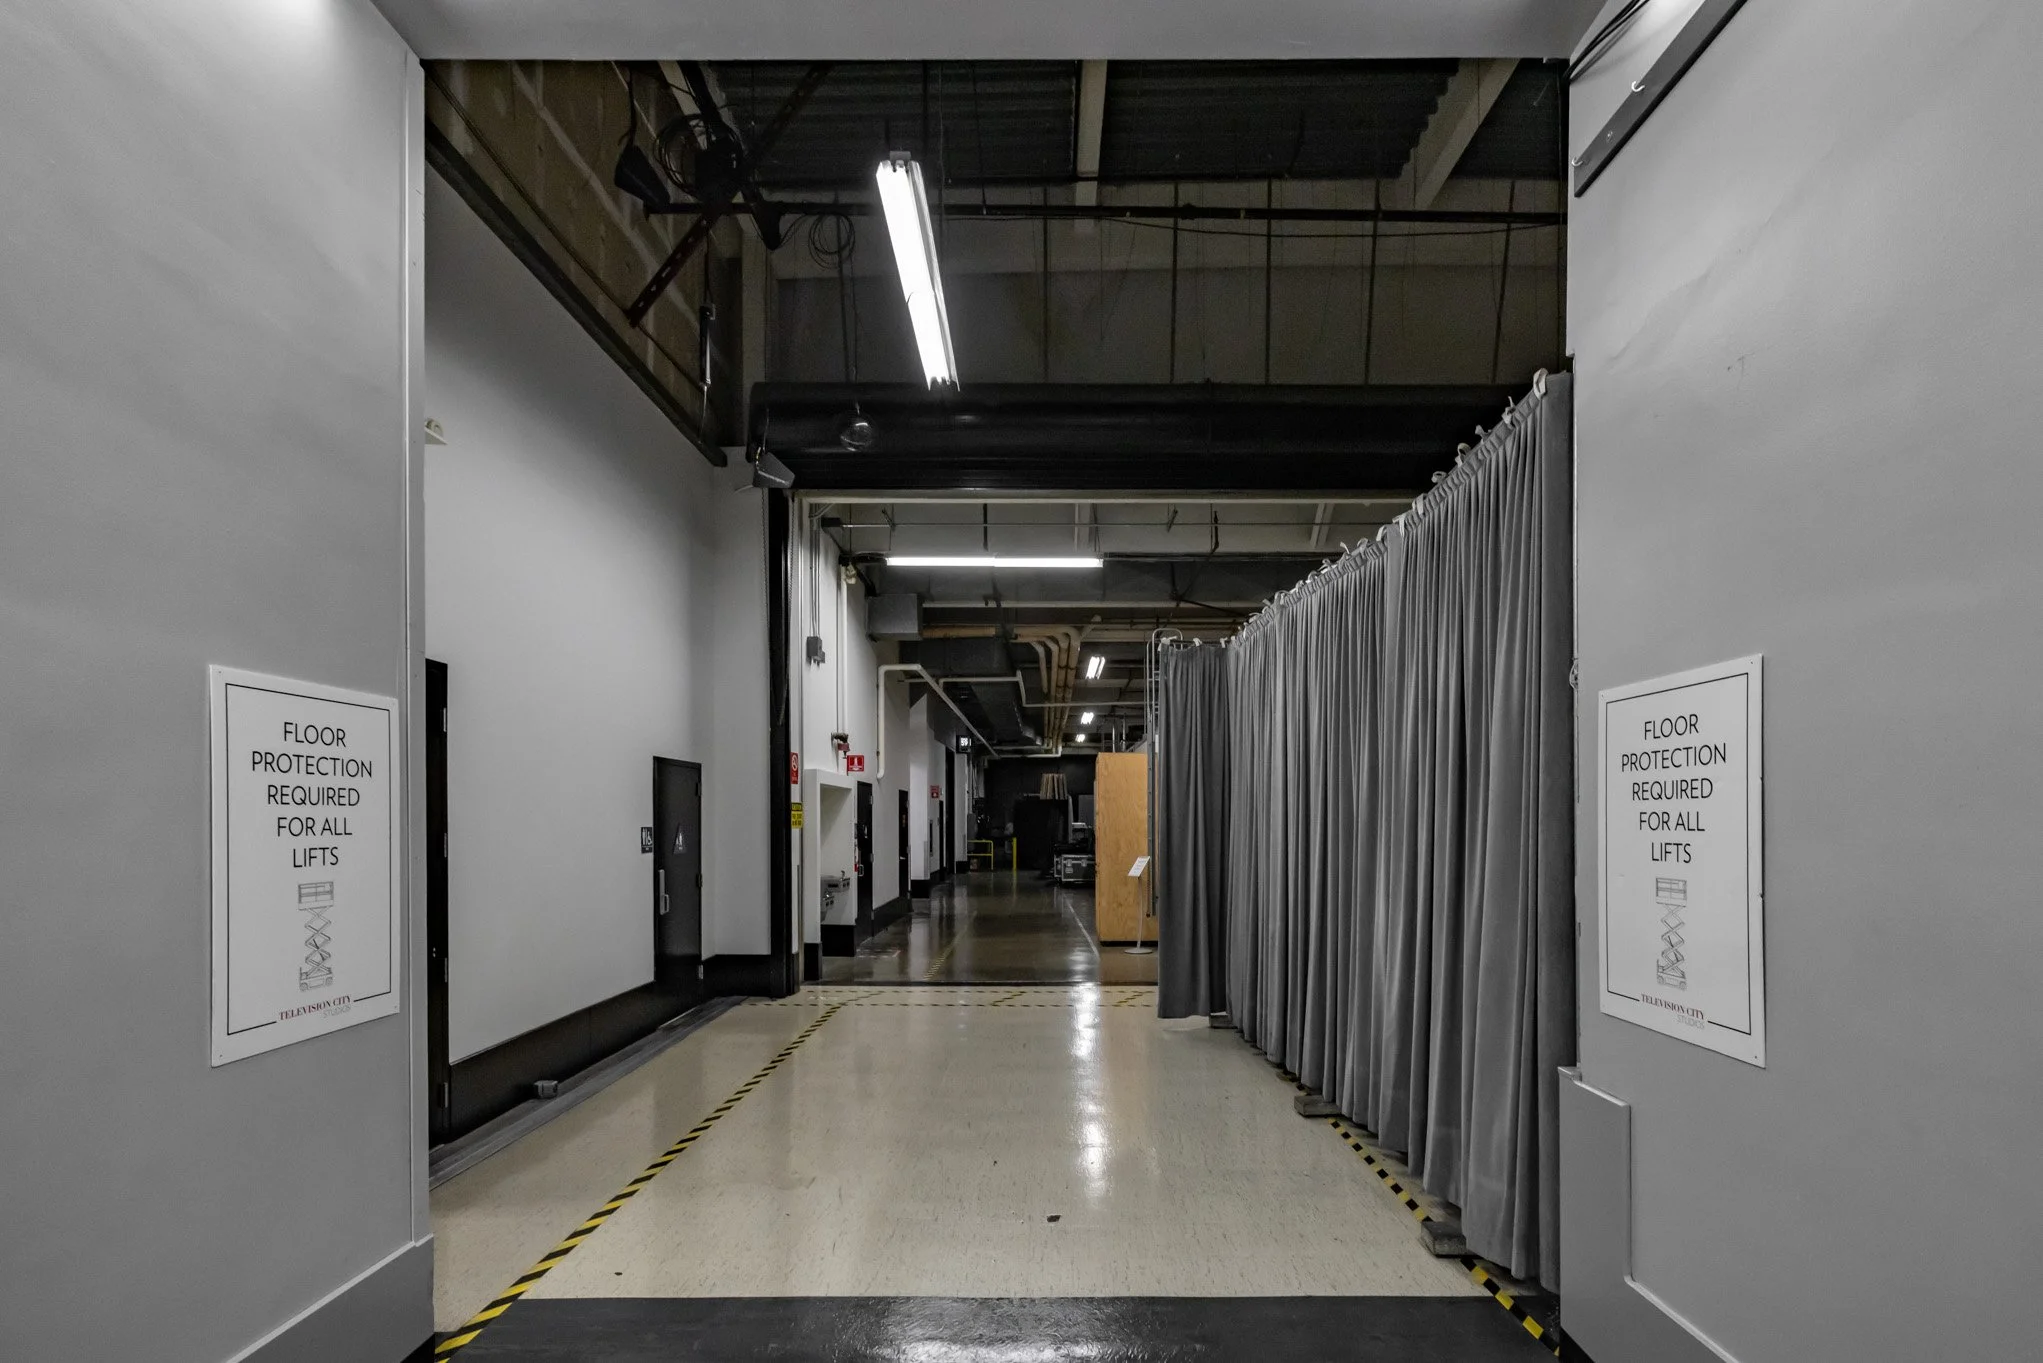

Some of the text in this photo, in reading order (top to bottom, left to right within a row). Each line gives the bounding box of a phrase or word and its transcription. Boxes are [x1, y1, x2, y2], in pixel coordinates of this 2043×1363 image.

[284, 722, 346, 747] FLOOR
[1645, 714, 1699, 740] FLOOR
[252, 751, 372, 778] PROTECTION
[1622, 743, 1726, 772] PROTECTION
[268, 785, 360, 806] REQUIRED
[1633, 778, 1713, 800] REQUIRED
[278, 817, 352, 837] FOR ALL
[1640, 811, 1705, 831] FOR ALL
[293, 847, 338, 868] LIFTS
[1652, 842, 1691, 863] LIFTS
[279, 995, 352, 1021] TELEVISION CITY
[1641, 993, 1704, 1020] TELEVISION CITY
